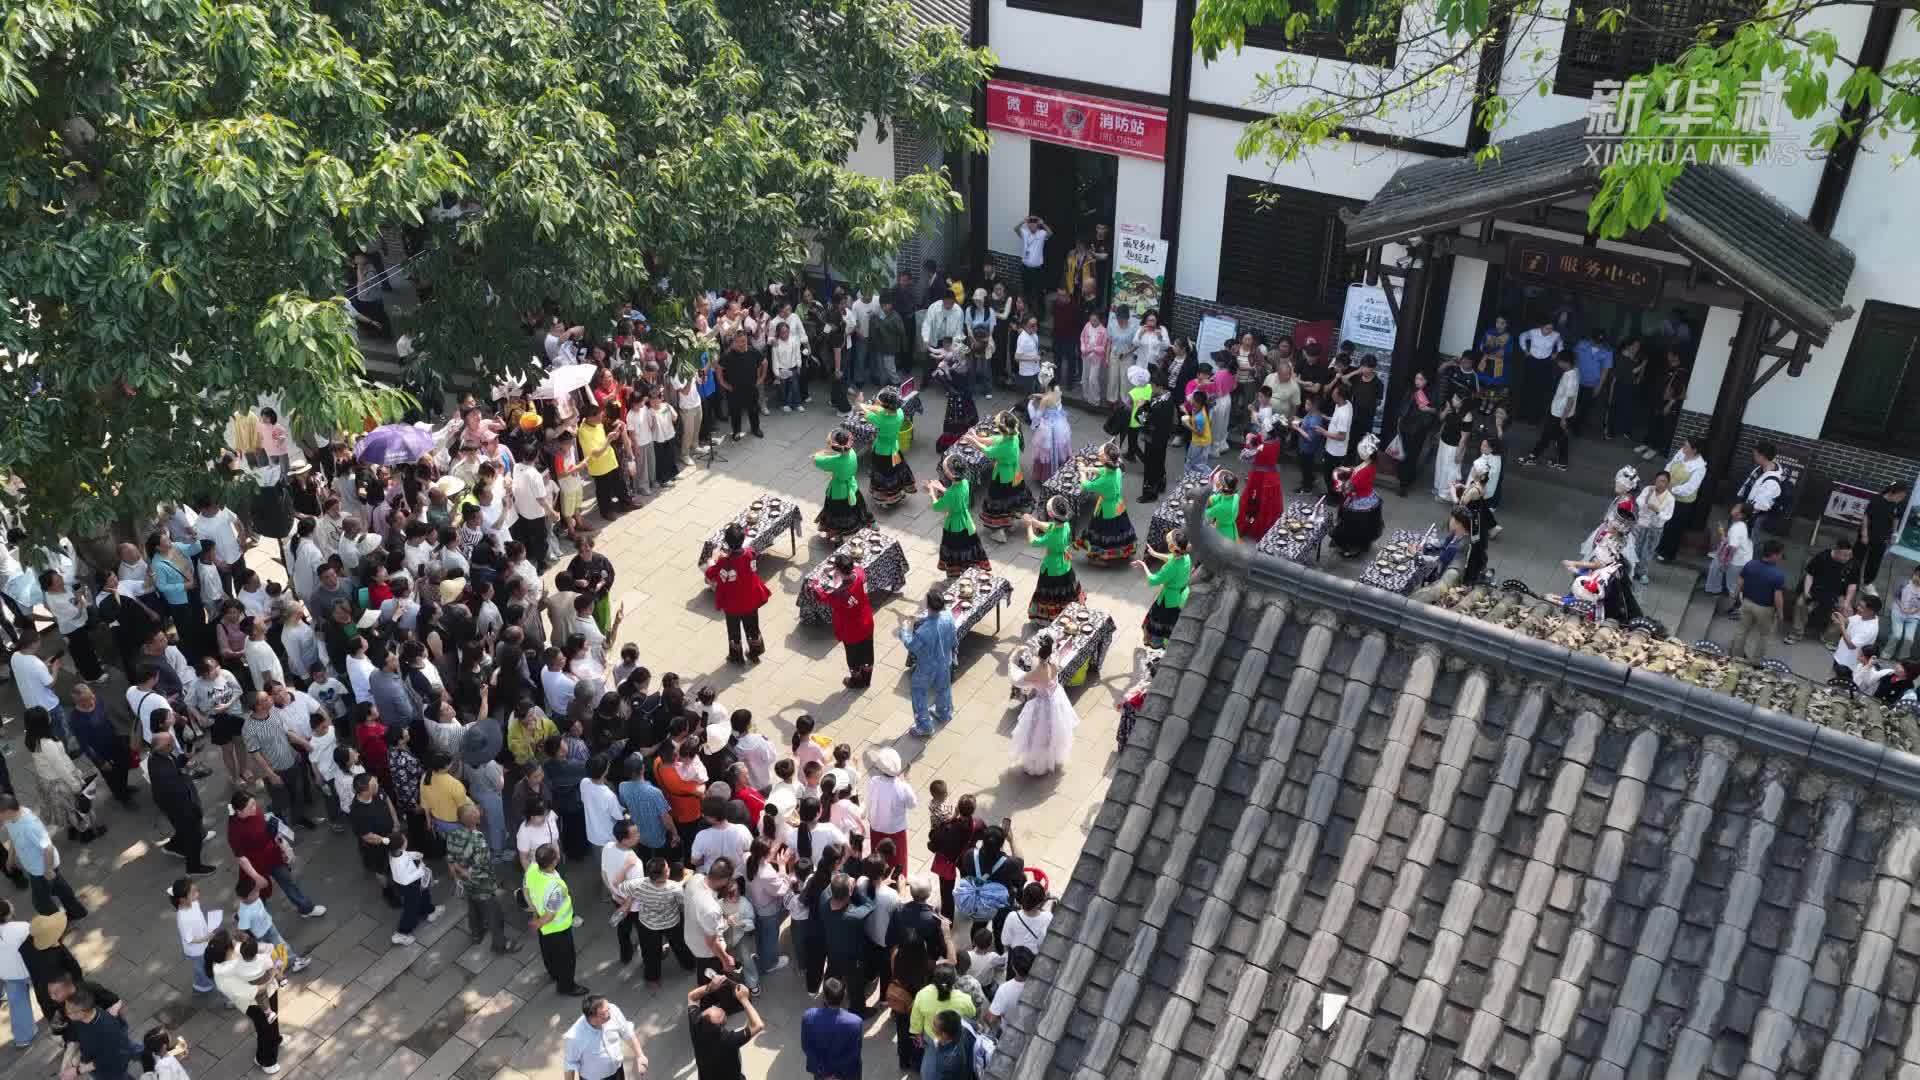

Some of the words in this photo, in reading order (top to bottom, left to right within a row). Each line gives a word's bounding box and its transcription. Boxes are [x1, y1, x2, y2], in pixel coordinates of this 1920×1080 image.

[1007, 95, 1049, 117] 微型
[1100, 112, 1145, 136] 消防站
[1559, 255, 1648, 287] 服务中心
